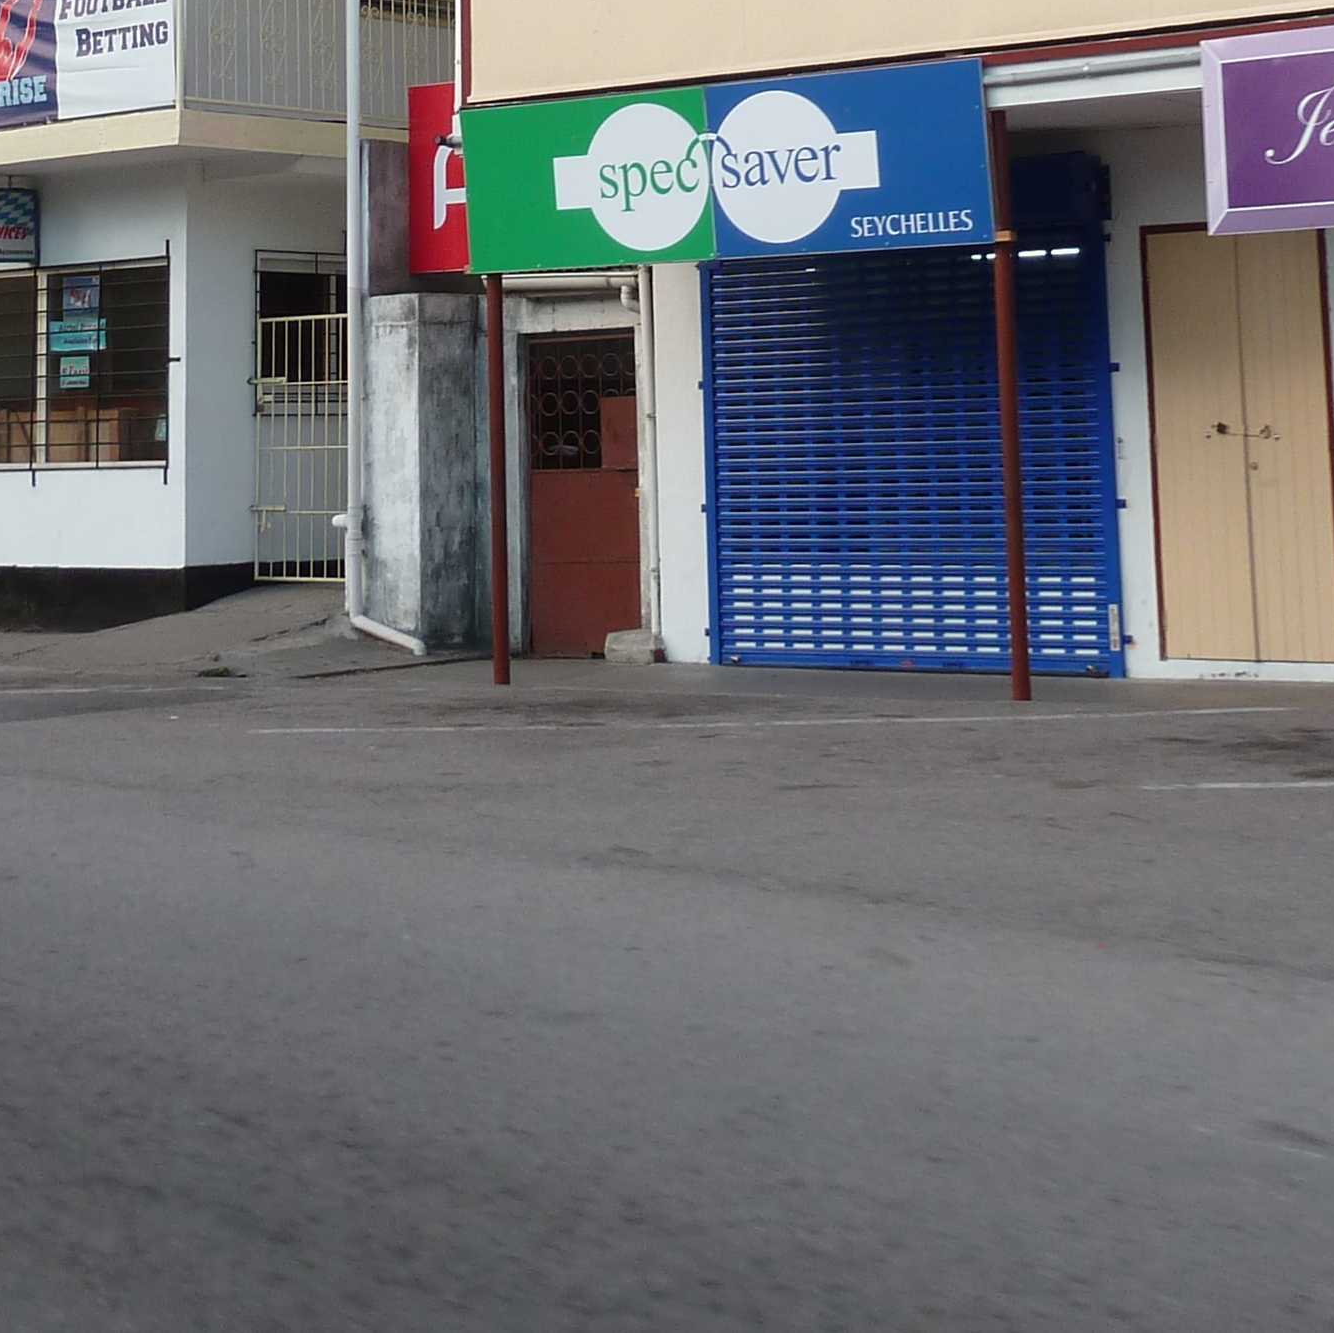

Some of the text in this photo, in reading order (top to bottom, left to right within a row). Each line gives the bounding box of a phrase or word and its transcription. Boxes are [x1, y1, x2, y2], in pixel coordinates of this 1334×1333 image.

[75, 20, 169, 58] BETTING
[599, 143, 842, 213] spec saver
[850, 209, 974, 239] SEYCHELLES
